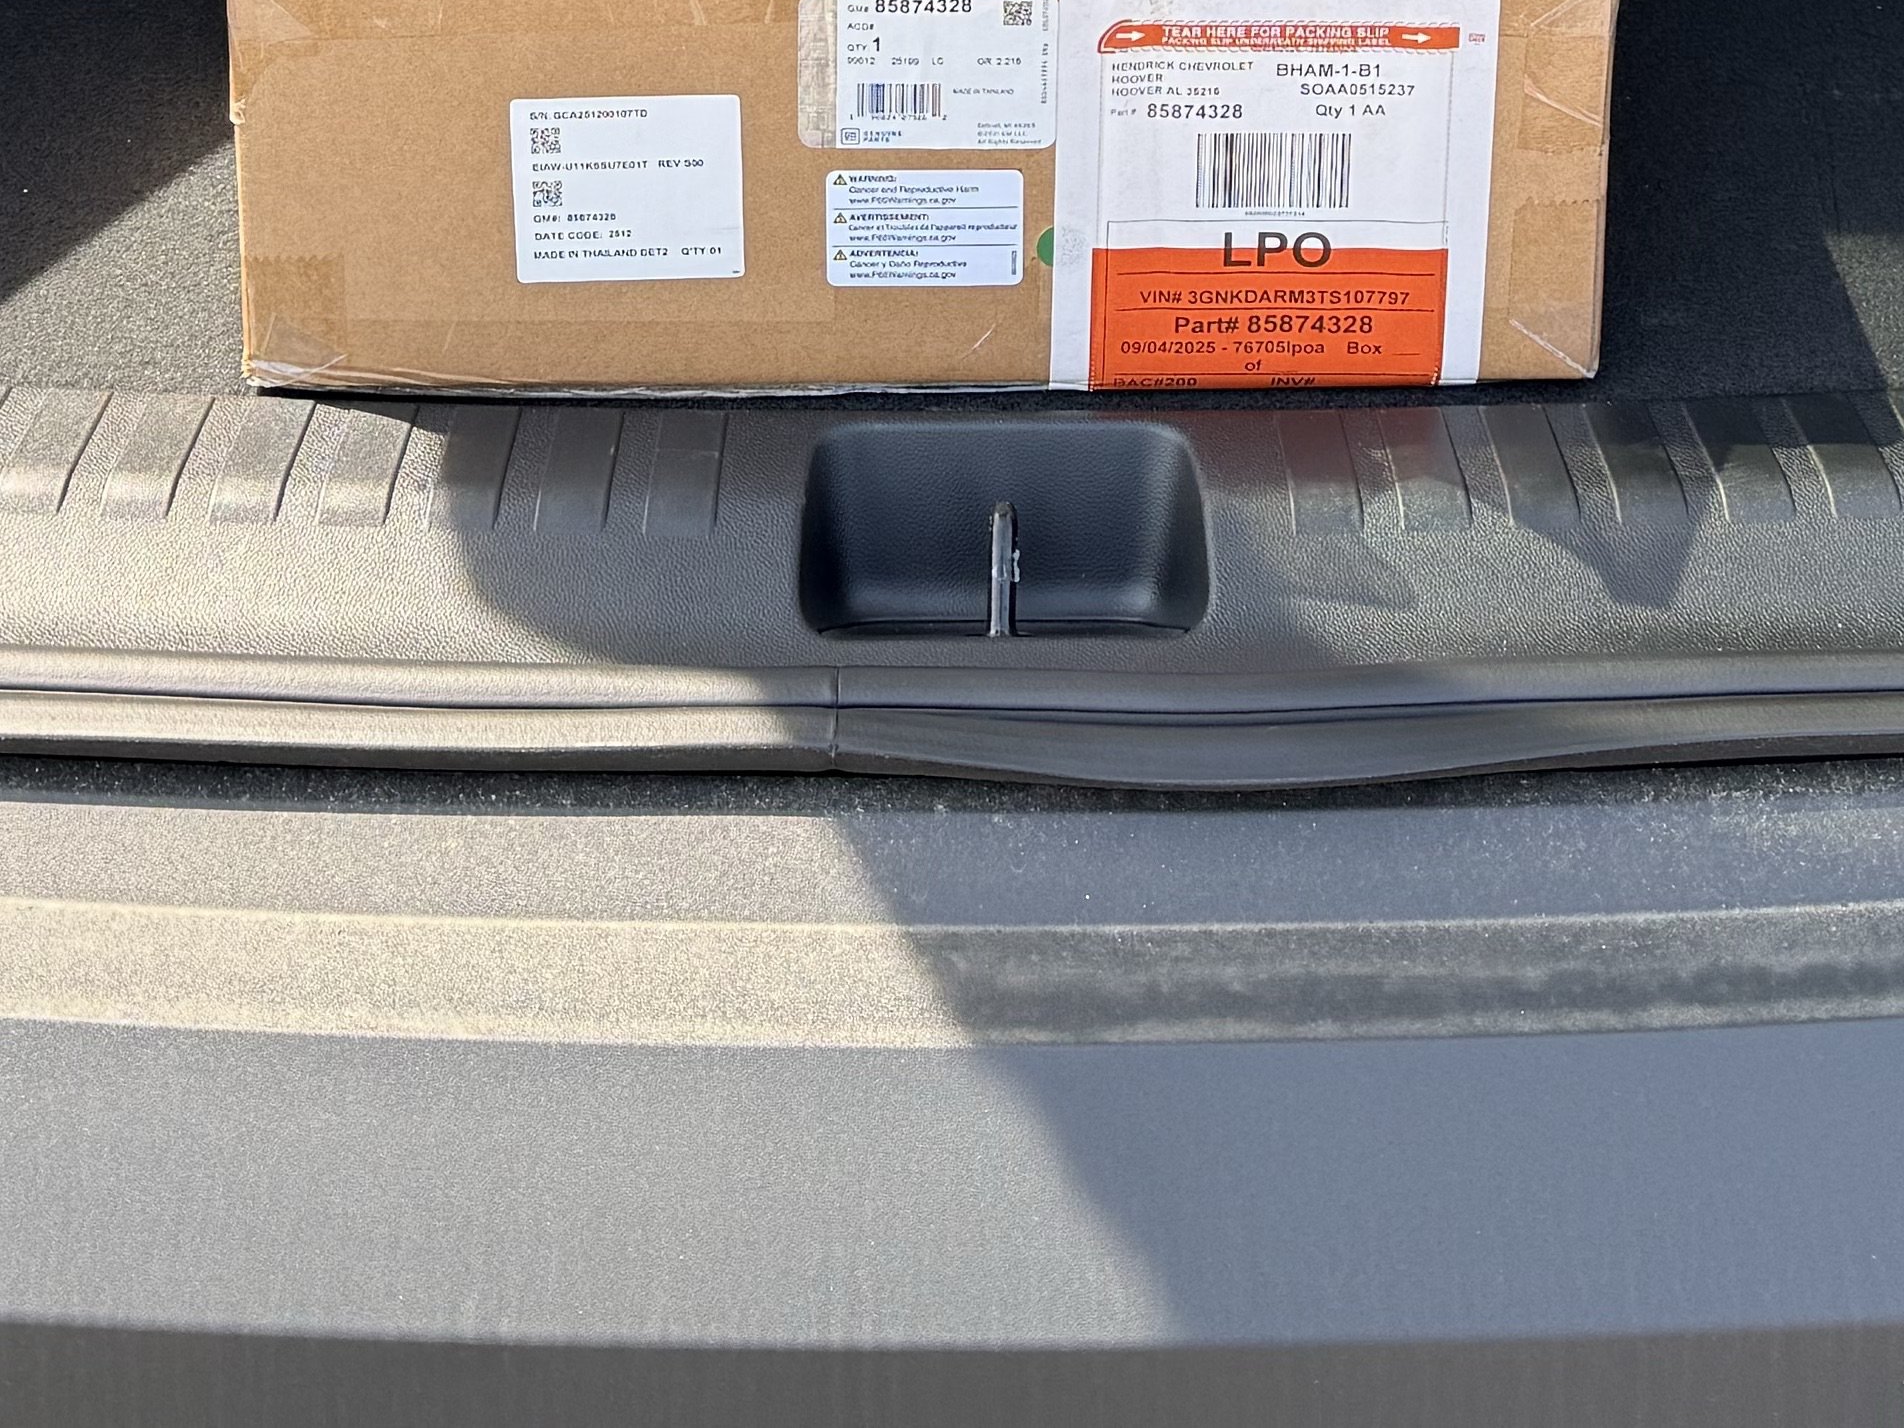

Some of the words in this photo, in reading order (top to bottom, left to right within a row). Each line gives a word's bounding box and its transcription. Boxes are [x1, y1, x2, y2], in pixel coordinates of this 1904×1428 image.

[1163, 26, 1202, 38] TEAR
[1207, 26, 1249, 38] HERE
[1251, 26, 1281, 38] FOR
[1286, 26, 1352, 38] PACKING
[1357, 26, 1389, 38] SLIP
[873, 37, 880, 52] 1
[1112, 61, 1174, 72] HENDRICK
[1179, 61, 1254, 72] CHEVROLET
[1276, 64, 1381, 78] BHAM-1-B1
[1111, 73, 1163, 84] HOOVER
[1111, 86, 1162, 97] HOOVER
[1166, 86, 1183, 97] AL
[1300, 83, 1416, 97] SOAA0515237
[1146, 103, 1243, 120] 85874328
[1315, 104, 1343, 119] Qty
[1362, 104, 1386, 116] AA
[848, 185, 879, 194] Cancer
[881, 185, 897, 194] and
[899, 185, 954, 194] Reproductive
[535, 232, 564, 241] DATE
[534, 251, 564, 259] MADE
[568, 250, 579, 259] IN
[583, 249, 637, 258] THAILAND
[1223, 231, 1332, 269] LPO
[1140, 290, 1182, 305] VIN#
[1187, 290, 1411, 305] 3GNKDARM3TS107797
[1174, 315, 1239, 334] Part#
[1247, 315, 1373, 334] 85874328
[1120, 340, 1217, 356] 09/04/2025
[1347, 340, 1382, 356] Box
[1244, 359, 1262, 371] of
